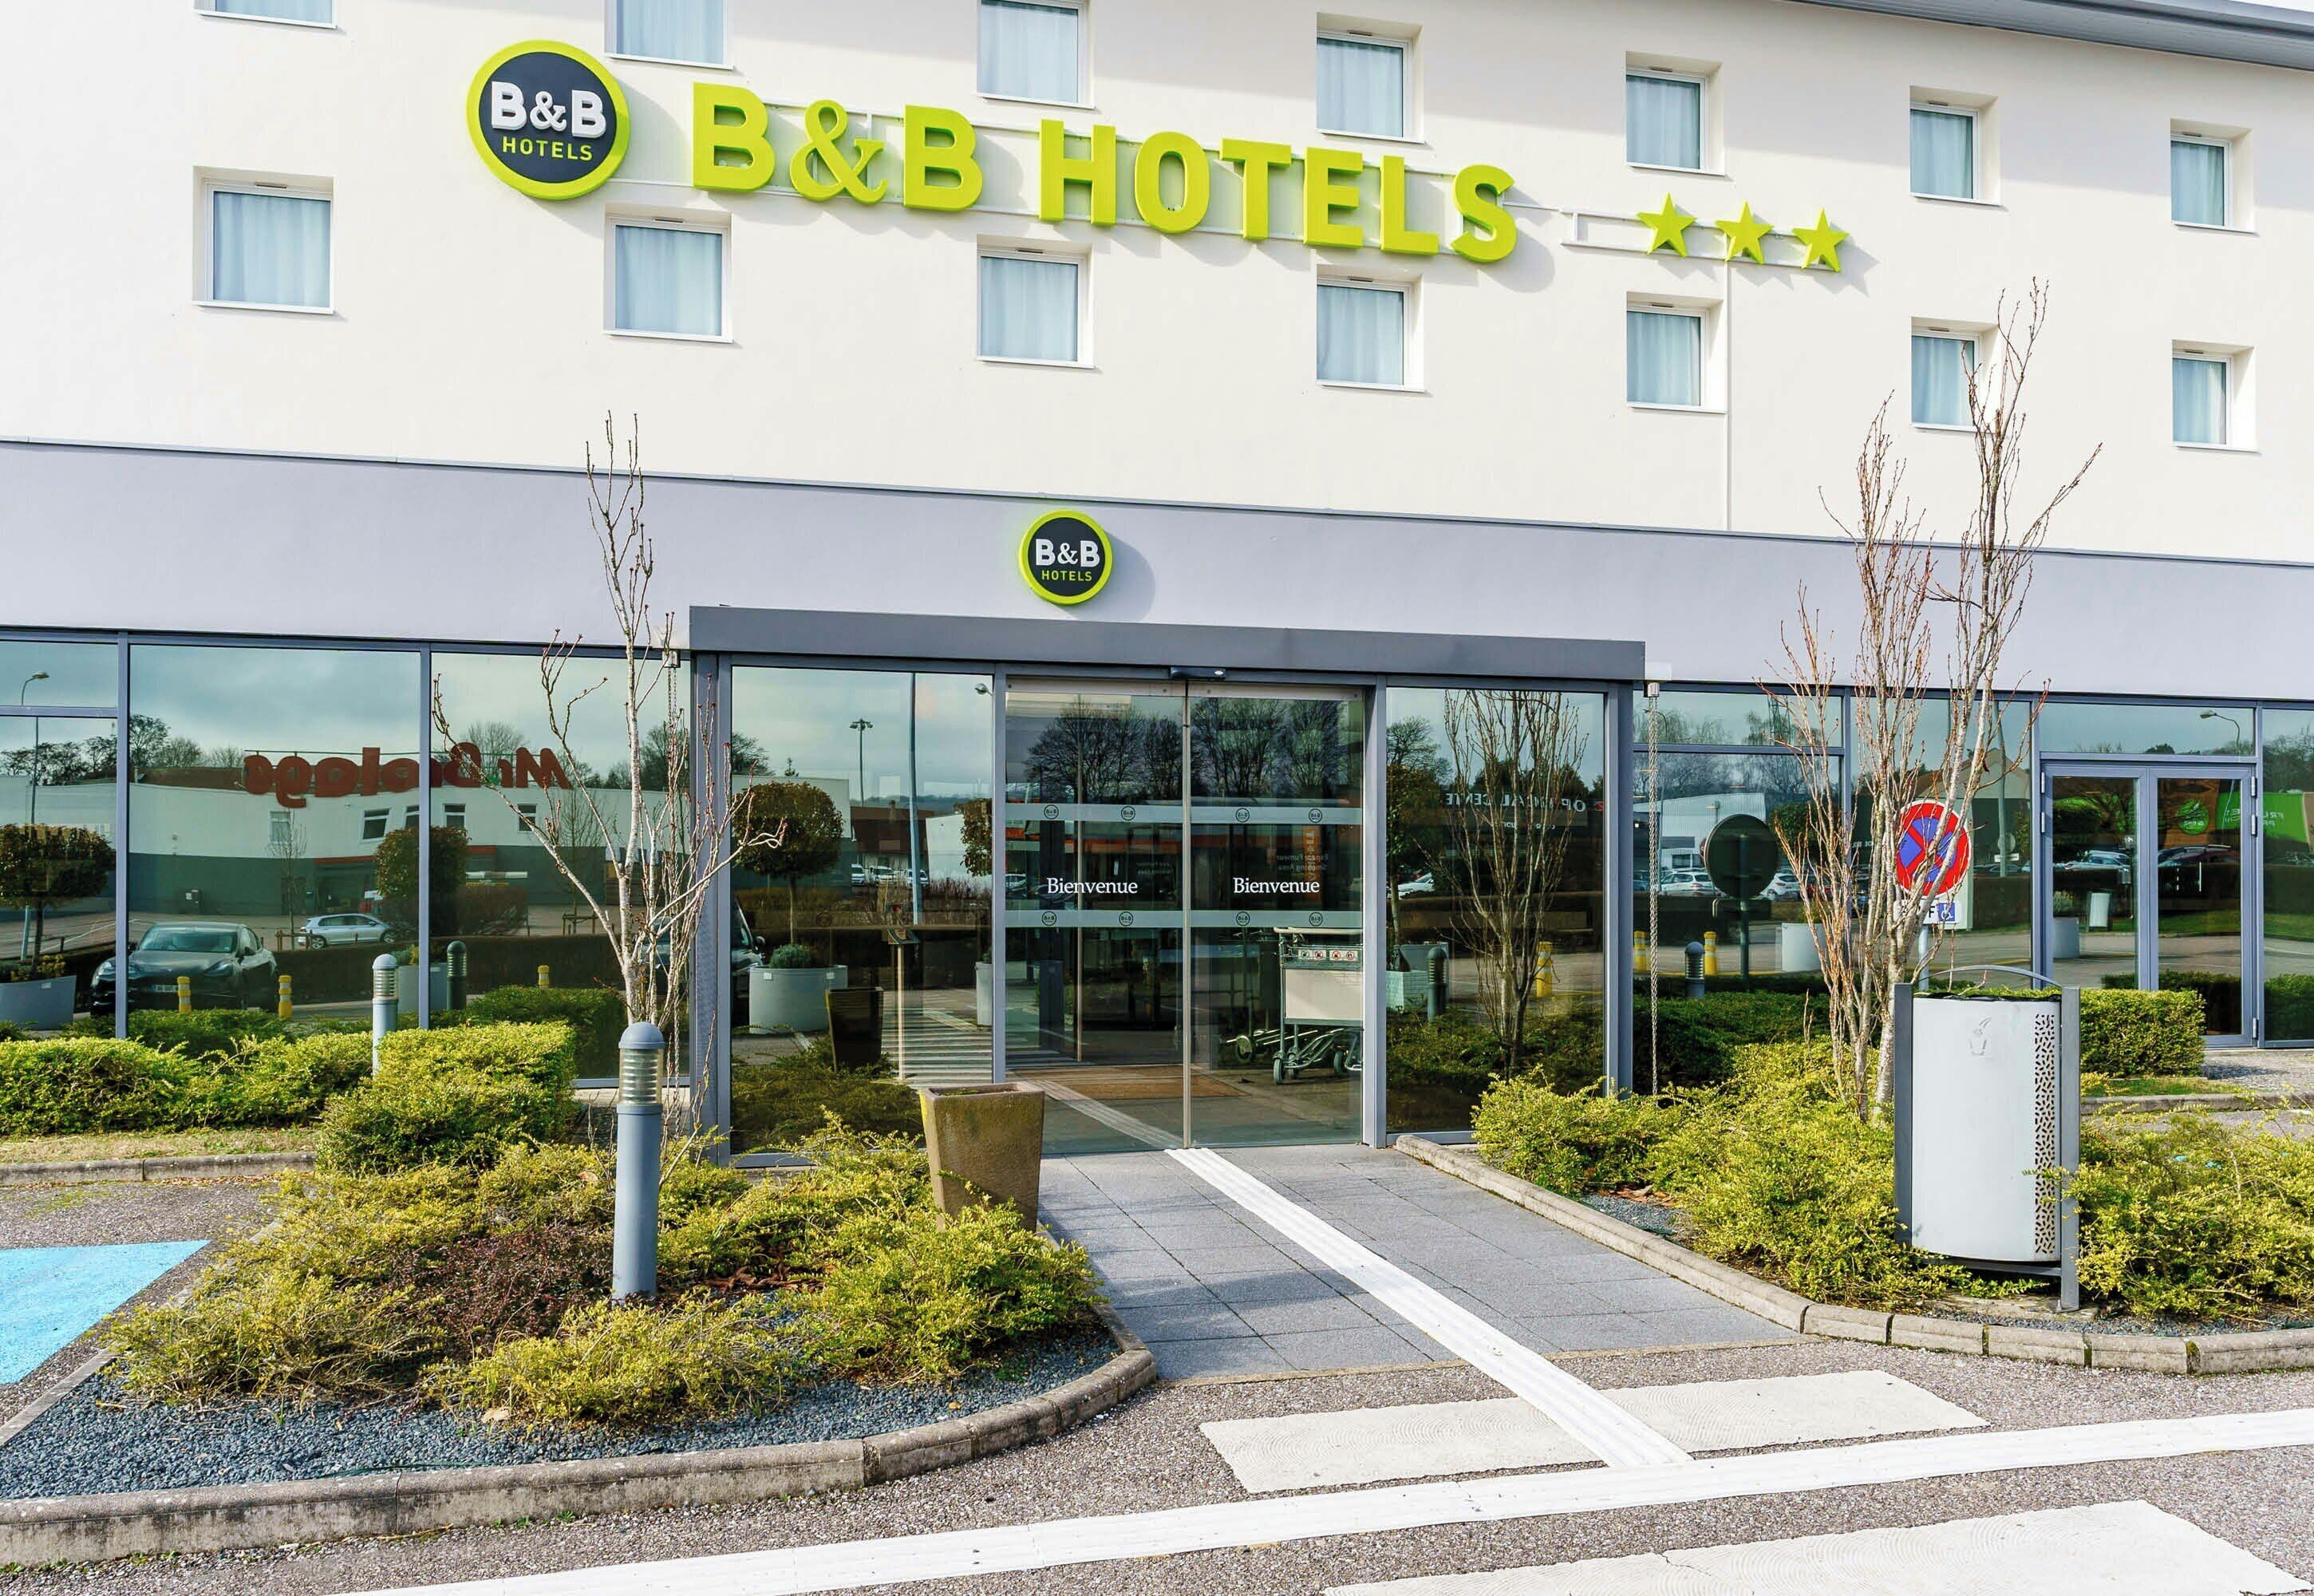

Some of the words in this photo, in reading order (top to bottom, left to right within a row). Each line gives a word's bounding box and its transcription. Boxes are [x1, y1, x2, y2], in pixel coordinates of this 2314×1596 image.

[492, 81, 606, 139] B&B
[502, 136, 593, 161] HOTELS
[693, 82, 983, 211] B&B
[1039, 119, 1517, 263] HOTELS
[1036, 538, 1100, 567] B&B
[1041, 570, 1092, 582] HOTELS
[1046, 877, 1139, 894] Bienvenue
[1232, 877, 1321, 894] Bienvenue
